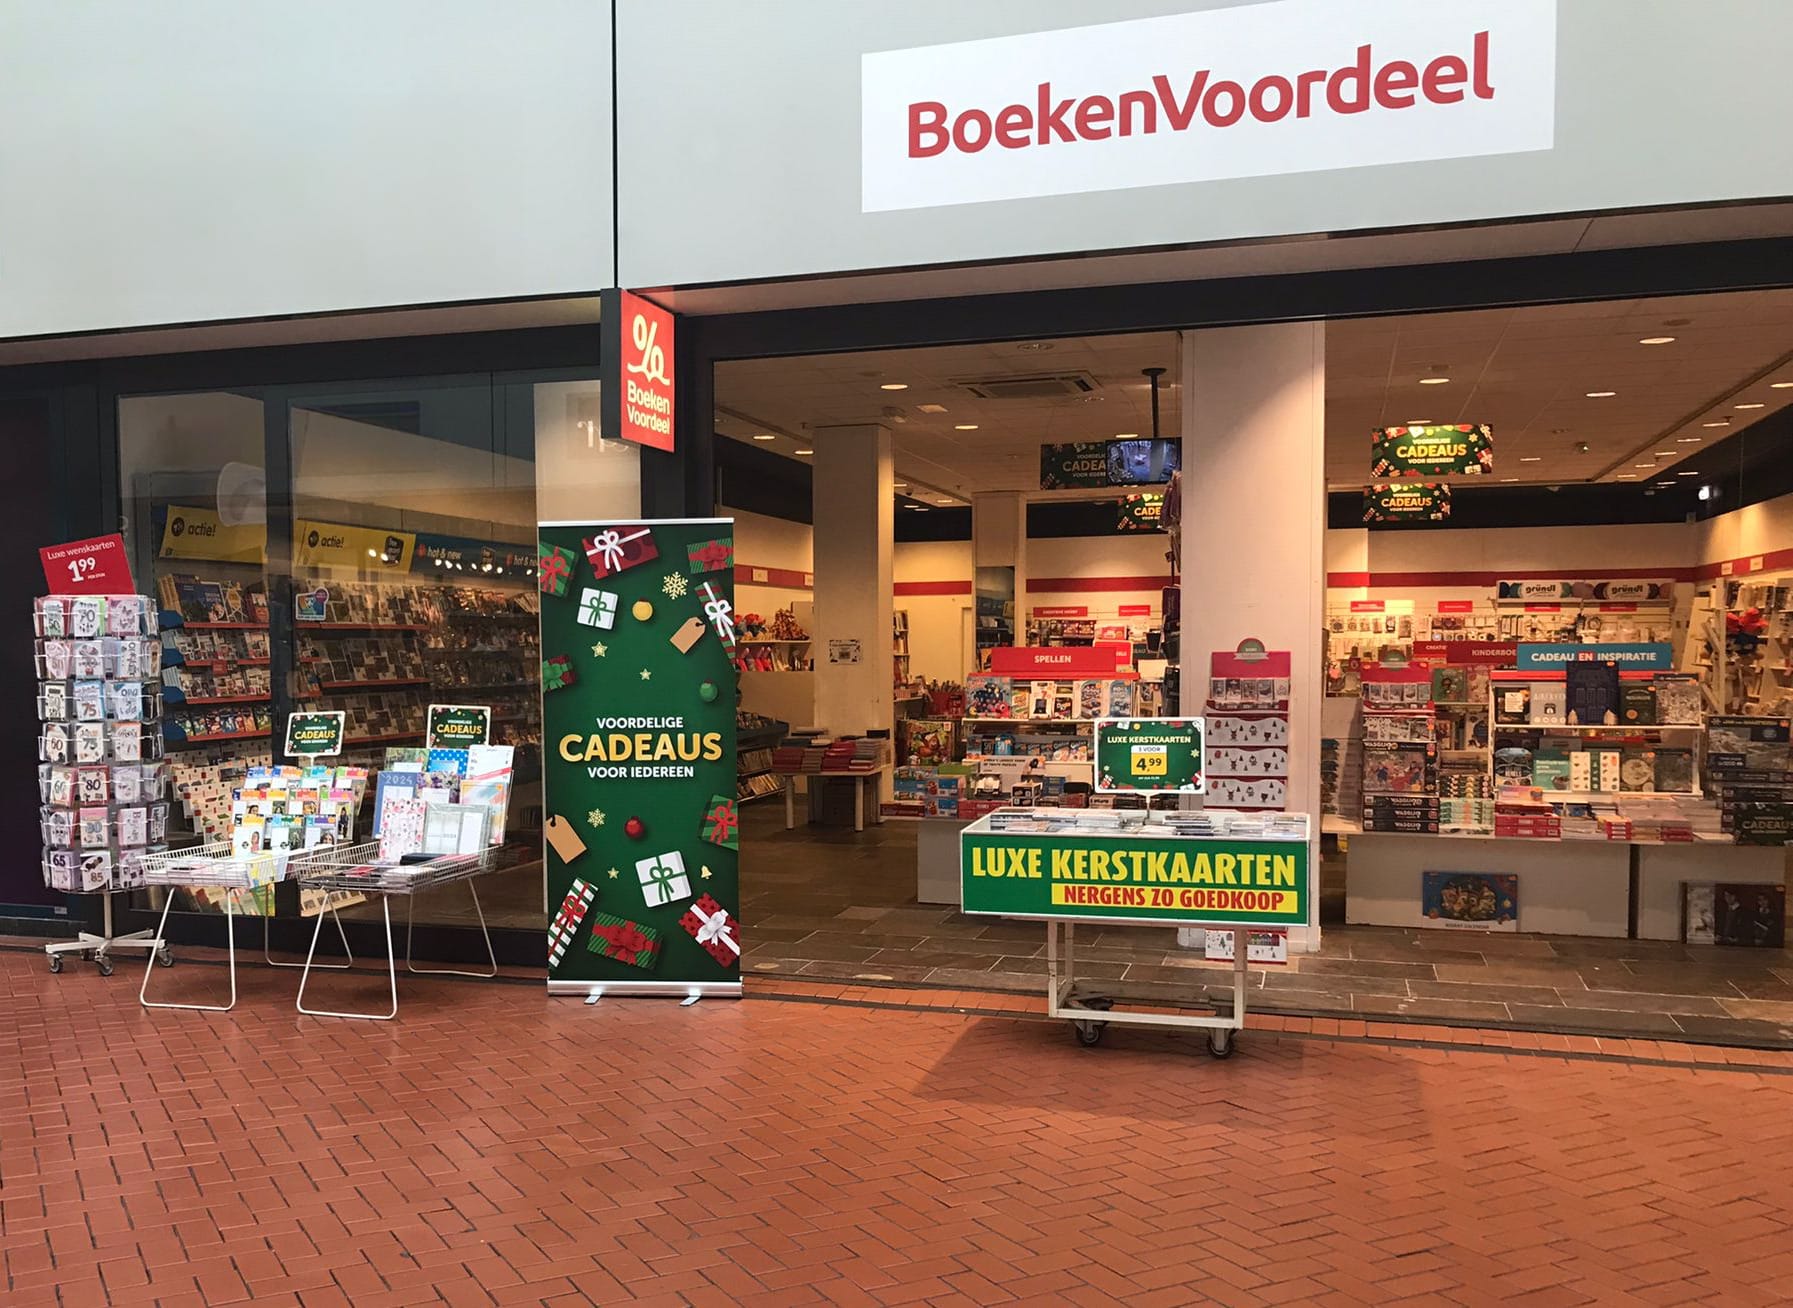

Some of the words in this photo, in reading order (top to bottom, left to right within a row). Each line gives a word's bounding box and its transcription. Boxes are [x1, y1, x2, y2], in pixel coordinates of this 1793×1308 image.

[908, 30, 1495, 158] BoekenVoordeel
[627, 380, 670, 415] Boeken
[627, 404, 670, 435] Voordeel
[1396, 444, 1467, 458] CADEAUS
[1062, 460, 1107, 472] CADEA
[1381, 498, 1433, 508] CADEAUS
[1134, 507, 1161, 516] CADE
[187, 522, 216, 537] actie!
[320, 535, 345, 549] actie!
[47, 551, 66, 561] Luxe
[66, 541, 116, 556] wenskaarten
[1525, 584, 1556, 595] gründl
[1471, 649, 1516, 657] KINDERBOE
[1531, 652, 1575, 662] CADEAU
[1578, 652, 1593, 662] EN
[1596, 651, 1657, 662] INSPIRATIE
[1034, 655, 1072, 664] SPELLEN
[82, 703, 97, 717] 75
[436, 724, 482, 735] CADEAUS
[596, 717, 684, 730] VOORDELIGE
[294, 730, 336, 740] CADEAUS
[1107, 736, 1128, 744] LUXE
[1129, 736, 1192, 744] KERSTKAARTEN
[559, 732, 722, 762] CADEAUS
[587, 766, 628, 778] VOOR
[630, 766, 694, 778] IEDEREEN
[85, 779, 101, 791] 80
[385, 774, 413, 786] 2024
[53, 854, 66, 867] 65
[972, 847, 1042, 879] LUXE
[1051, 848, 1297, 887] KERSTKAARTEN
[90, 872, 104, 882] 85
[1064, 885, 1145, 906] NERGENS
[1151, 888, 1175, 907] ZO
[1179, 889, 1285, 911] GOEDKOOP
